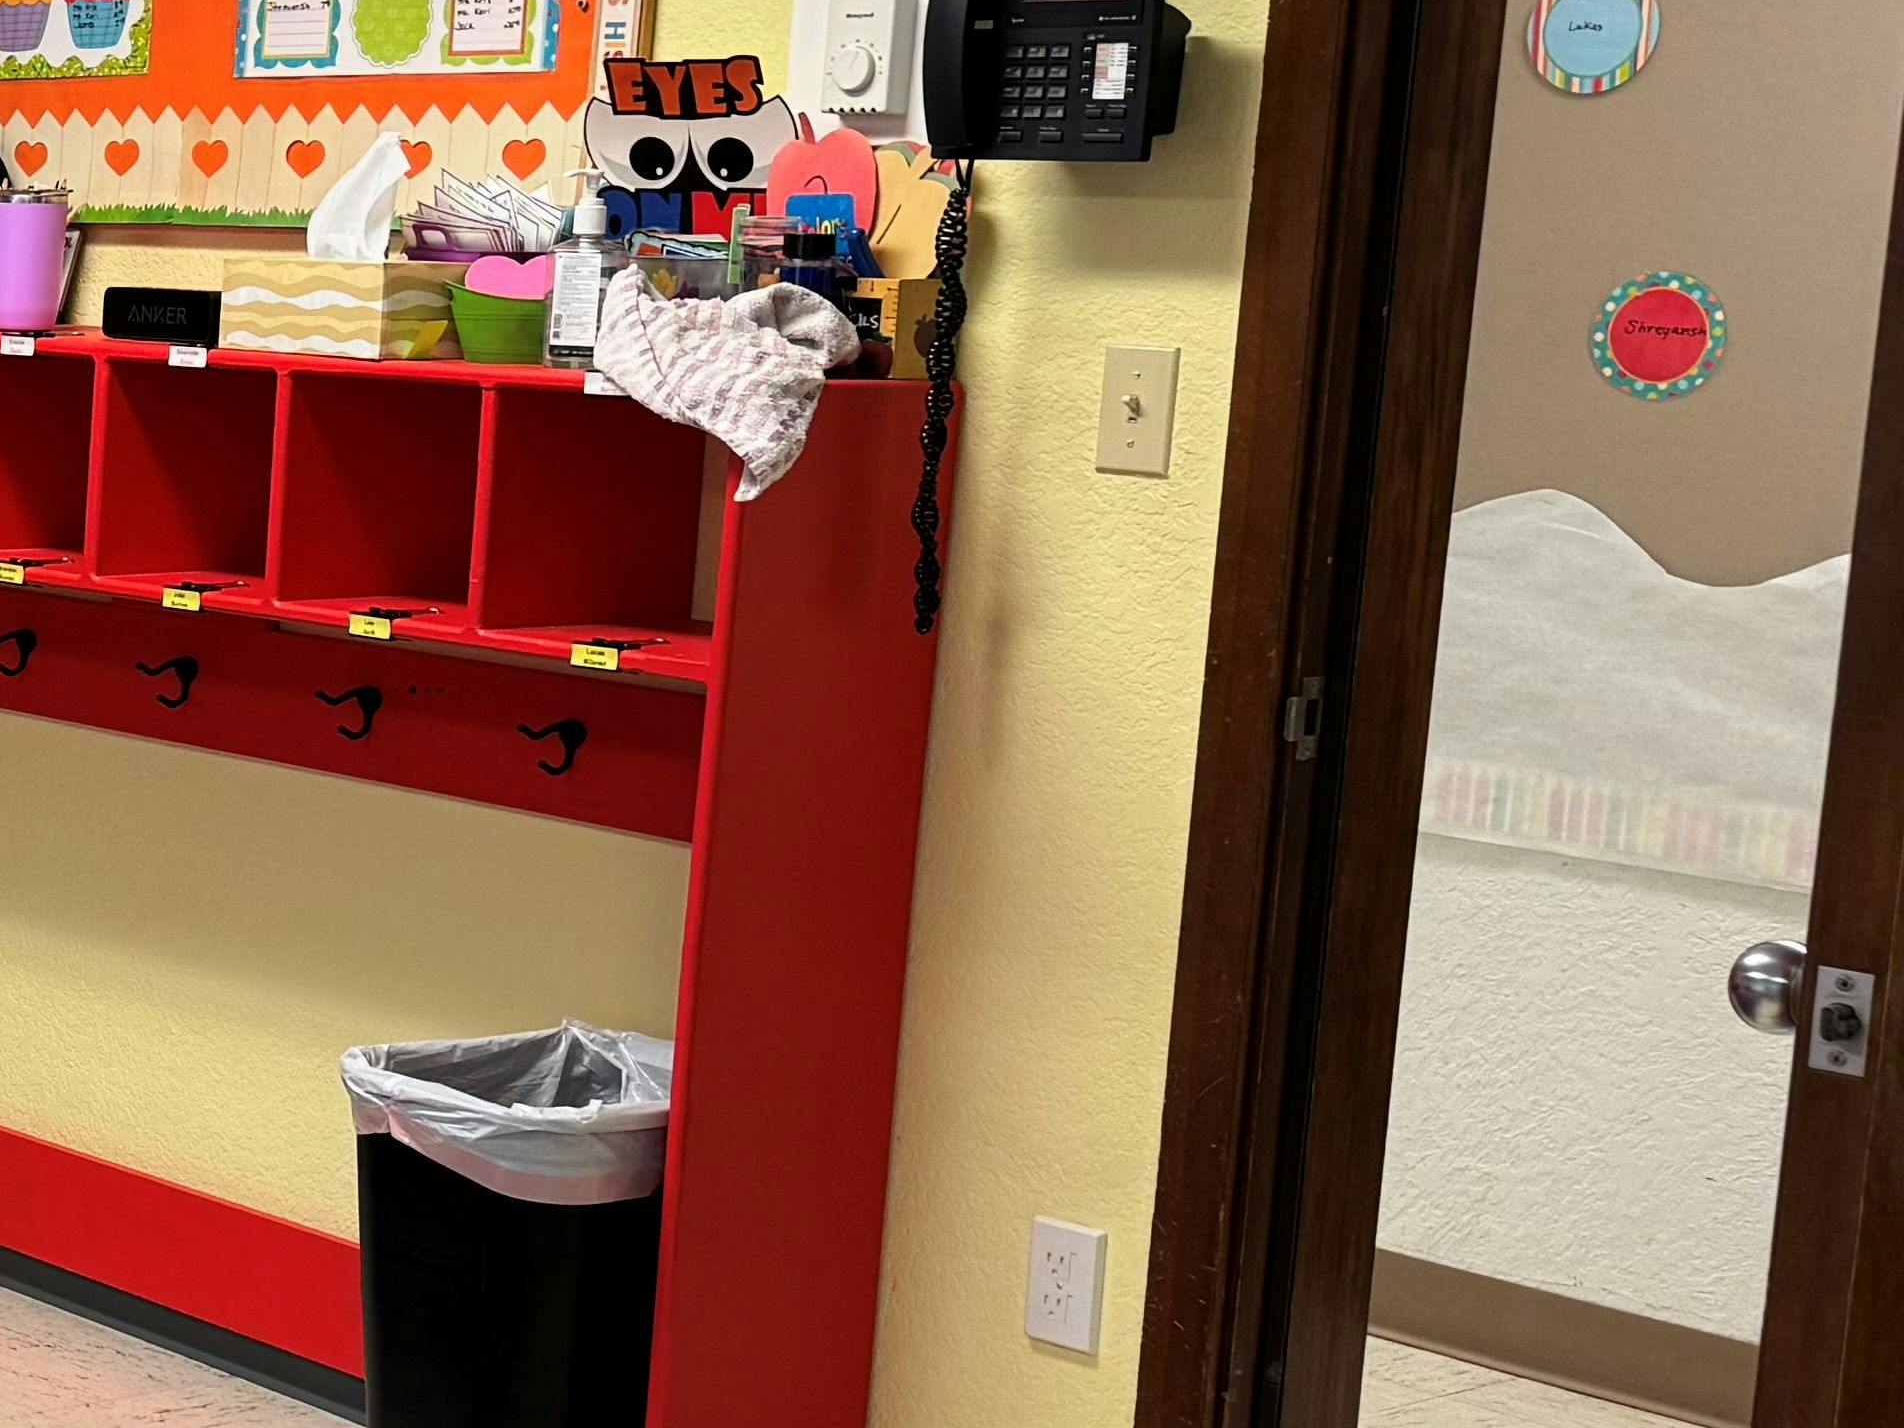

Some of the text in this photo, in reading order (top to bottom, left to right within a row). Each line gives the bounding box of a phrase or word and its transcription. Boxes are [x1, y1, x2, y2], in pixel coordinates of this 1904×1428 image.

[608, 58, 761, 116] EYES
[600, 190, 682, 243] ON
[128, 304, 187, 326] ANKER
